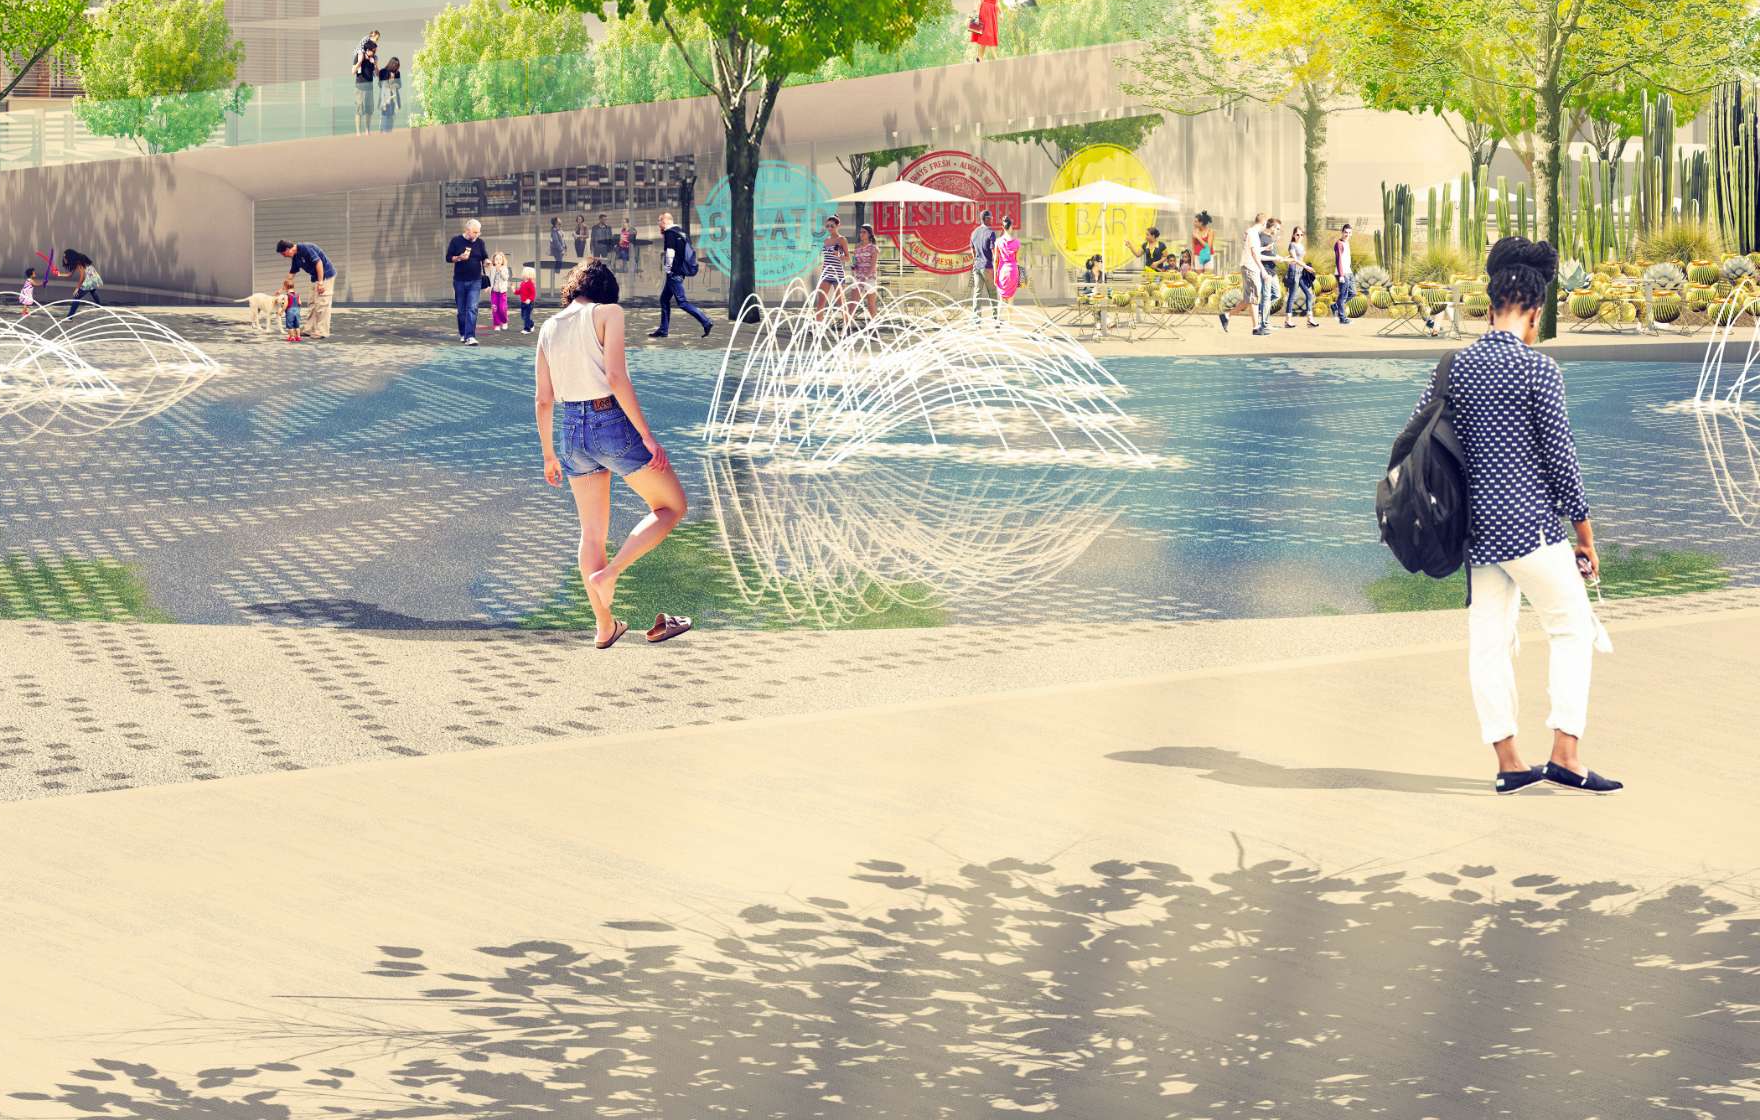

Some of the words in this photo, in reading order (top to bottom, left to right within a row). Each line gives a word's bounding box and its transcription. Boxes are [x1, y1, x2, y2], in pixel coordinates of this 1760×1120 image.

[908, 166, 929, 183] LWAYS
[930, 160, 951, 170] FRESH
[709, 208, 828, 241] GATO
[882, 201, 945, 227] FRESH
[1076, 207, 1128, 236] BAR
